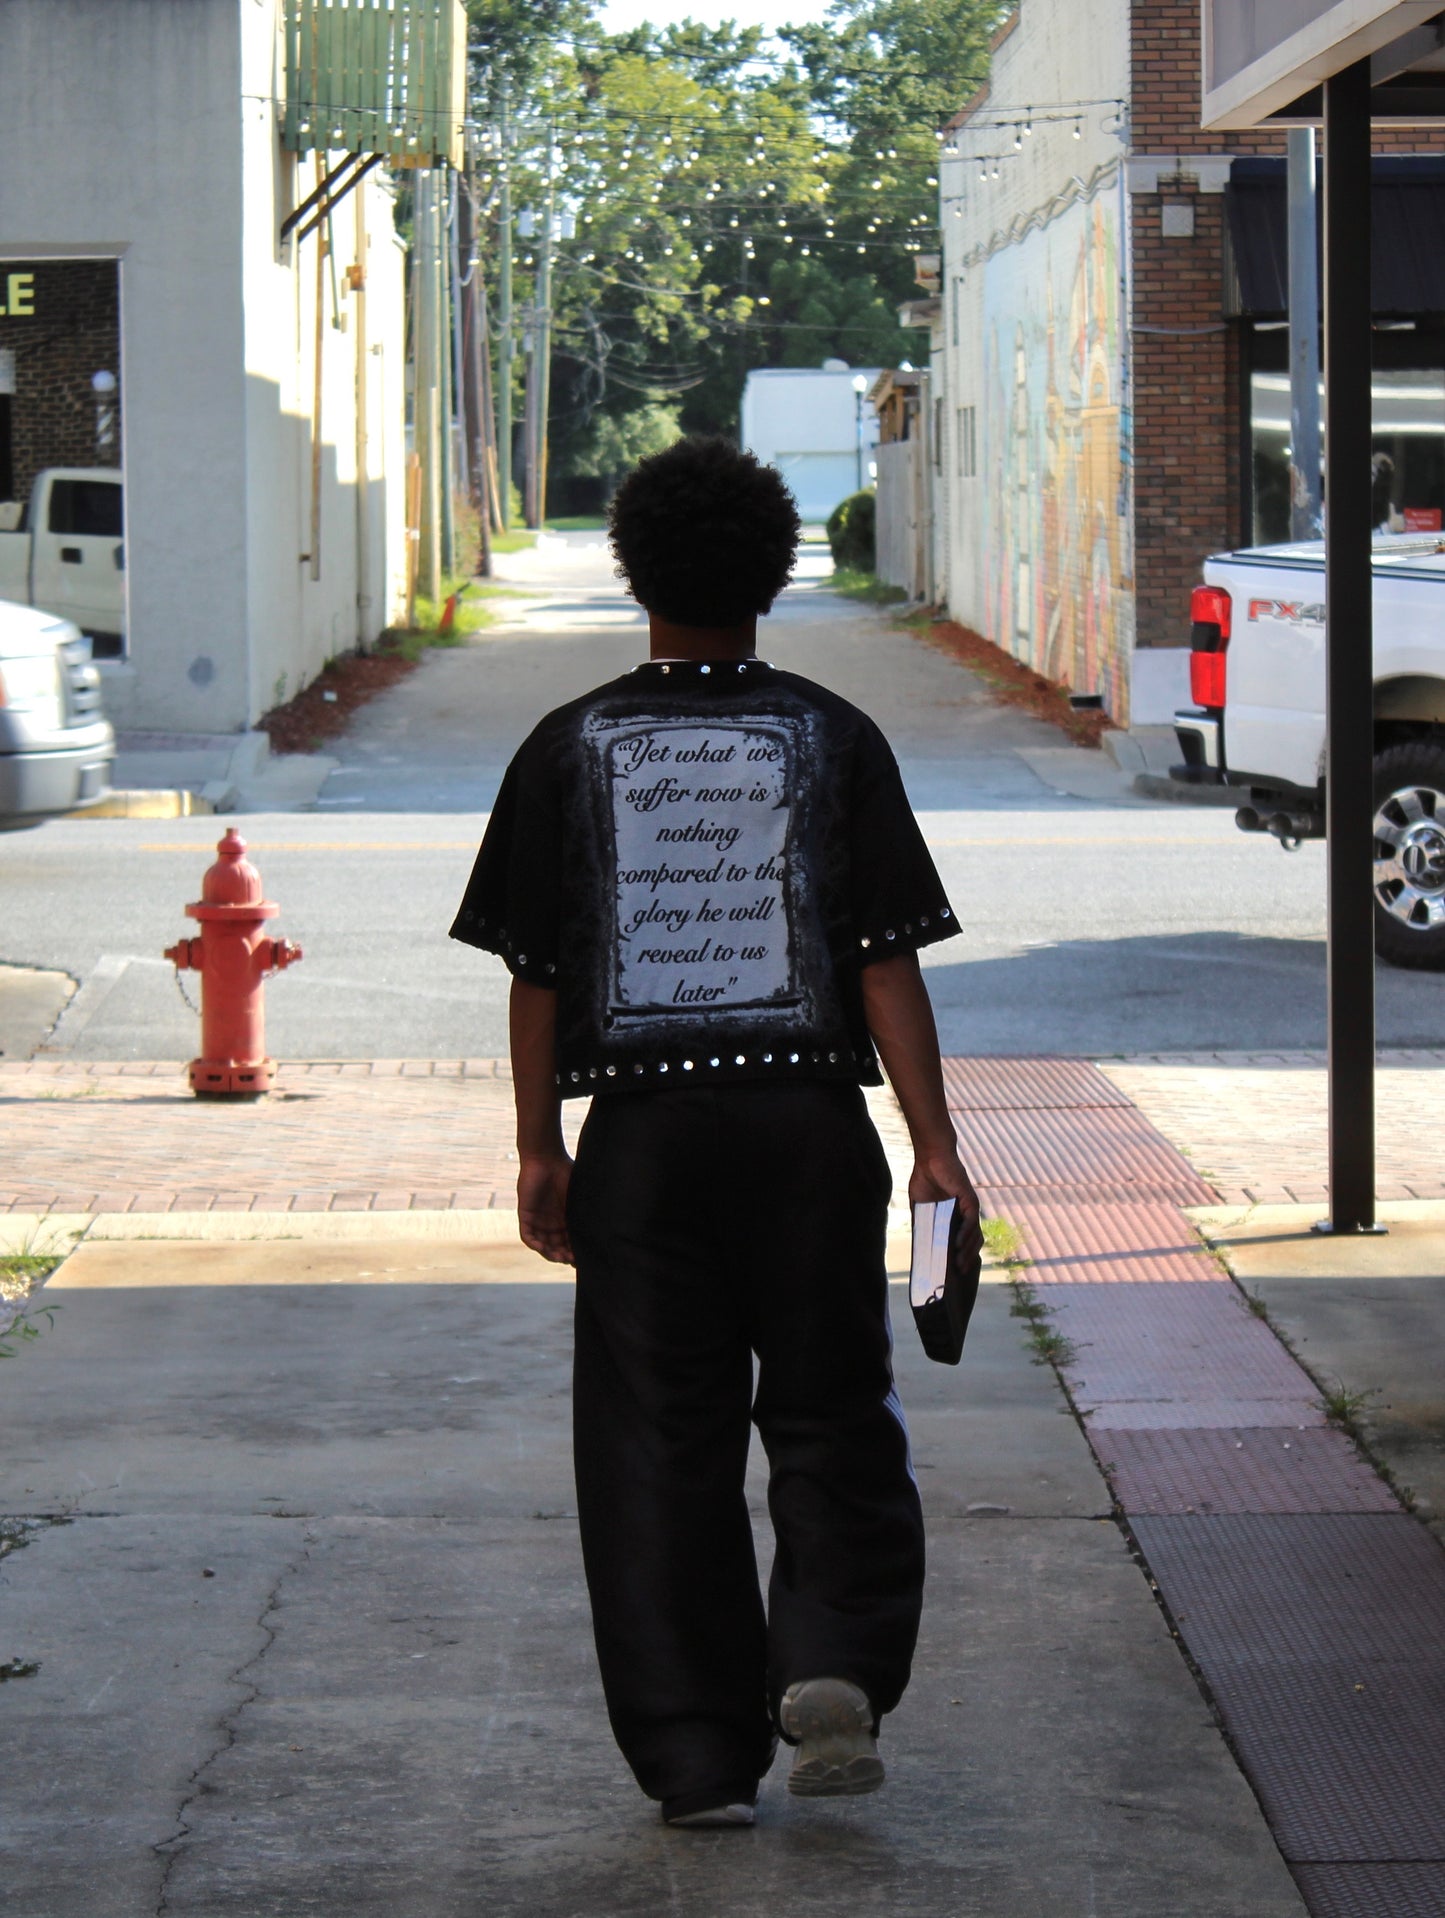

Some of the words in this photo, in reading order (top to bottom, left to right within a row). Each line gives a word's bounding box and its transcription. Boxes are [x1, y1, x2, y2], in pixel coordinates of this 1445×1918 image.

[0, 273, 34, 315] E
[1248, 598, 1326, 623] FX4
[675, 740, 737, 763] what
[747, 748, 781, 762] we
[625, 778, 693, 812] suffer
[694, 788, 745, 802] now
[748, 782, 771, 802] is
[655, 818, 742, 852] nothing
[616, 858, 724, 892] compared
[726, 866, 752, 882] to
[624, 899, 694, 933] glory
[696, 898, 726, 922] he
[728, 896, 777, 921] will
[637, 938, 711, 964] reveal
[712, 945, 738, 962] to
[740, 944, 768, 961] us
